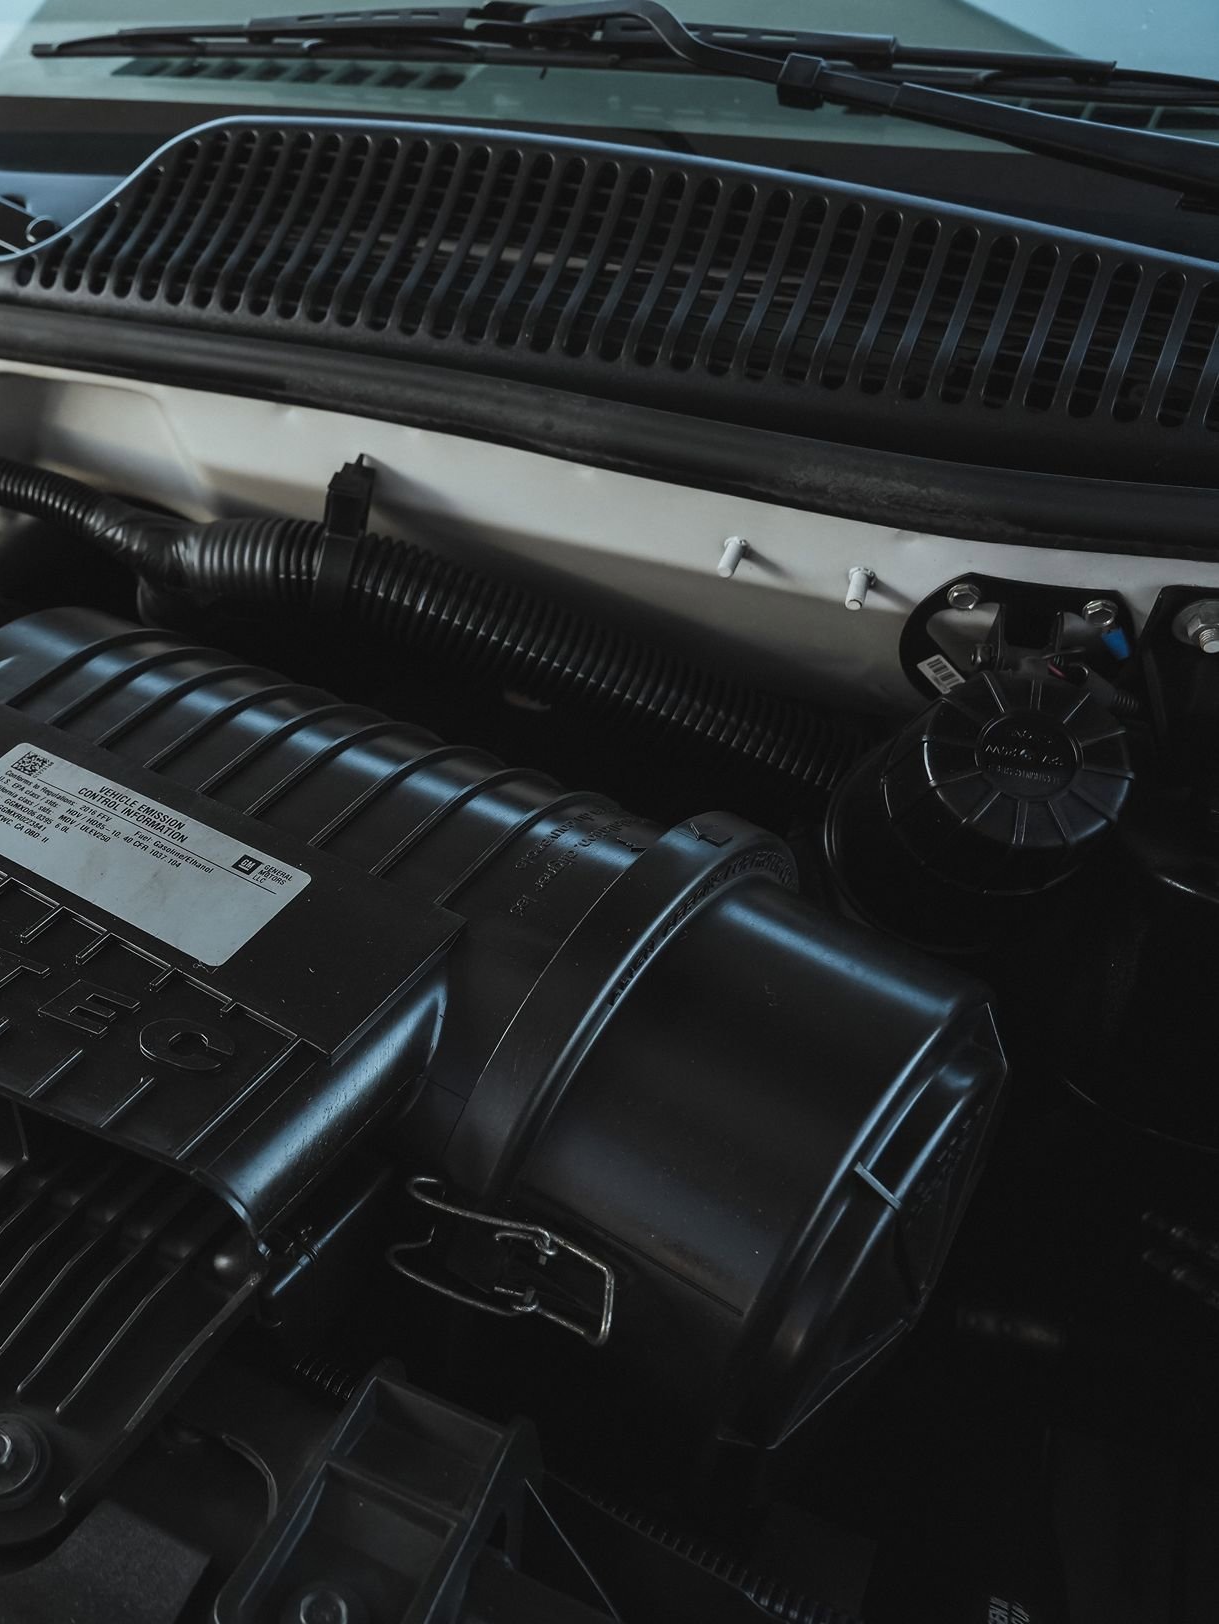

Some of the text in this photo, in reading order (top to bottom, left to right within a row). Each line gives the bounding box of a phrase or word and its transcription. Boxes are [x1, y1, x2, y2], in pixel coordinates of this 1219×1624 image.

[4, 798, 54, 825] GGMXD06.0395
[54, 823, 70, 834] 6.0L
[5, 770, 33, 786] Conforms
[40, 786, 78, 807] Regulations:
[79, 805, 98, 816] 2016
[96, 812, 113, 822] FFV
[133, 831, 153, 843] Fuel:
[153, 840, 214, 874] Gasoline/Ethanol
[11, 783, 26, 792] EPA
[24, 790, 41, 799] class
[66, 808, 83, 818] HDV
[123, 836, 134, 844] 40
[133, 840, 149, 851] CFR
[149, 849, 182, 868] 1037.104
[17, 796, 35, 806] class
[58, 814, 77, 825] MDV
[80, 824, 111, 843] ULEV250
[78, 788, 188, 843] CONTROL INFORMATION
[99, 786, 186, 830] VEHICLE EMISSION
[14, 823, 25, 832] CA
[23, 828, 42, 840] OBD:
[239, 858, 257, 871] GM
[252, 874, 267, 884] LLC
[257, 869, 287, 886] MOTORS
[264, 865, 293, 882] GENERAL
